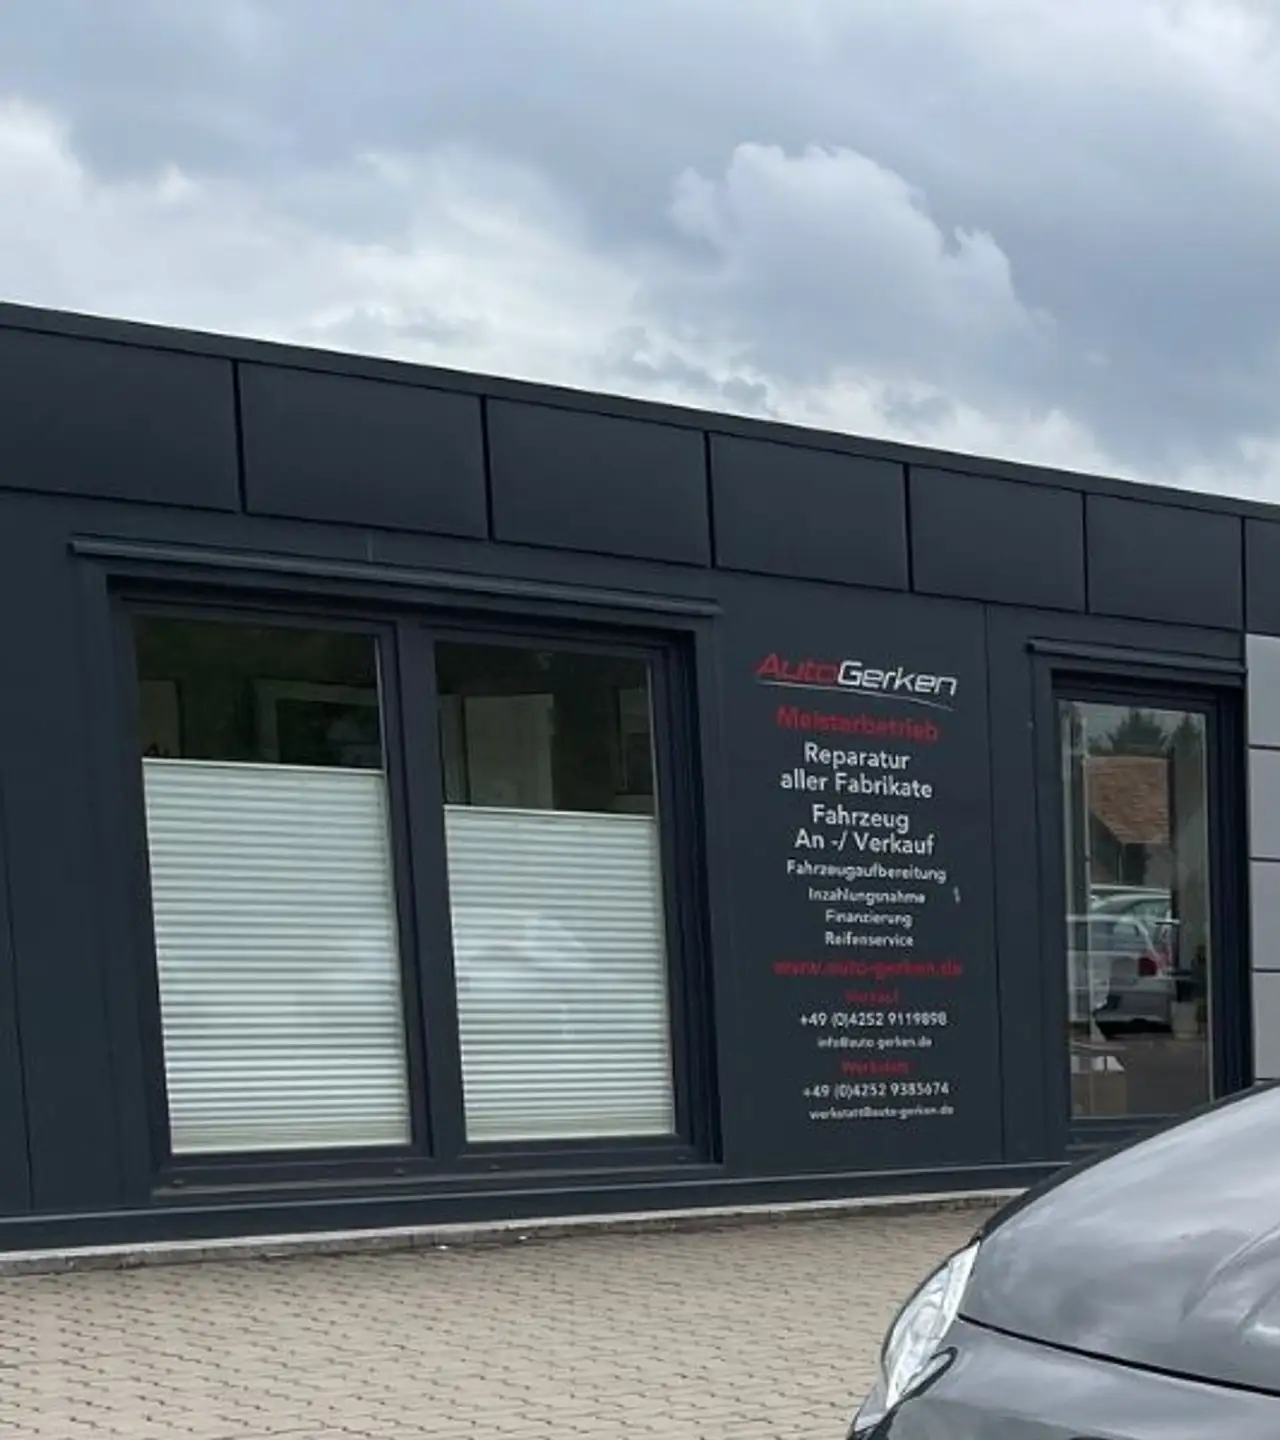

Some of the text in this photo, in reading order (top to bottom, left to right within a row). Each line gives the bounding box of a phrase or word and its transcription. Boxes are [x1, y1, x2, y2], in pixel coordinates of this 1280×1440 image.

[757, 653, 958, 695] AutoGerken
[776, 706, 938, 741] Meisterbetrieb
[804, 741, 911, 770] Reparatur
[780, 769, 933, 799] aller Fabrikate
[812, 804, 910, 834] Fahrzeug
[795, 828, 825, 850] An
[853, 832, 935, 855] Verkauf
[787, 859, 947, 883] Fahrzeugaufbereitung
[808, 887, 926, 906] Inzahlungsnahme
[825, 909, 913, 928] Finanzierung
[825, 931, 914, 947] Reifenservice
[801, 1012, 828, 1026] +49
[831, 1012, 884, 1028] (0)4252
[803, 1083, 829, 1098] +49
[834, 1083, 886, 1099] (0)4252
